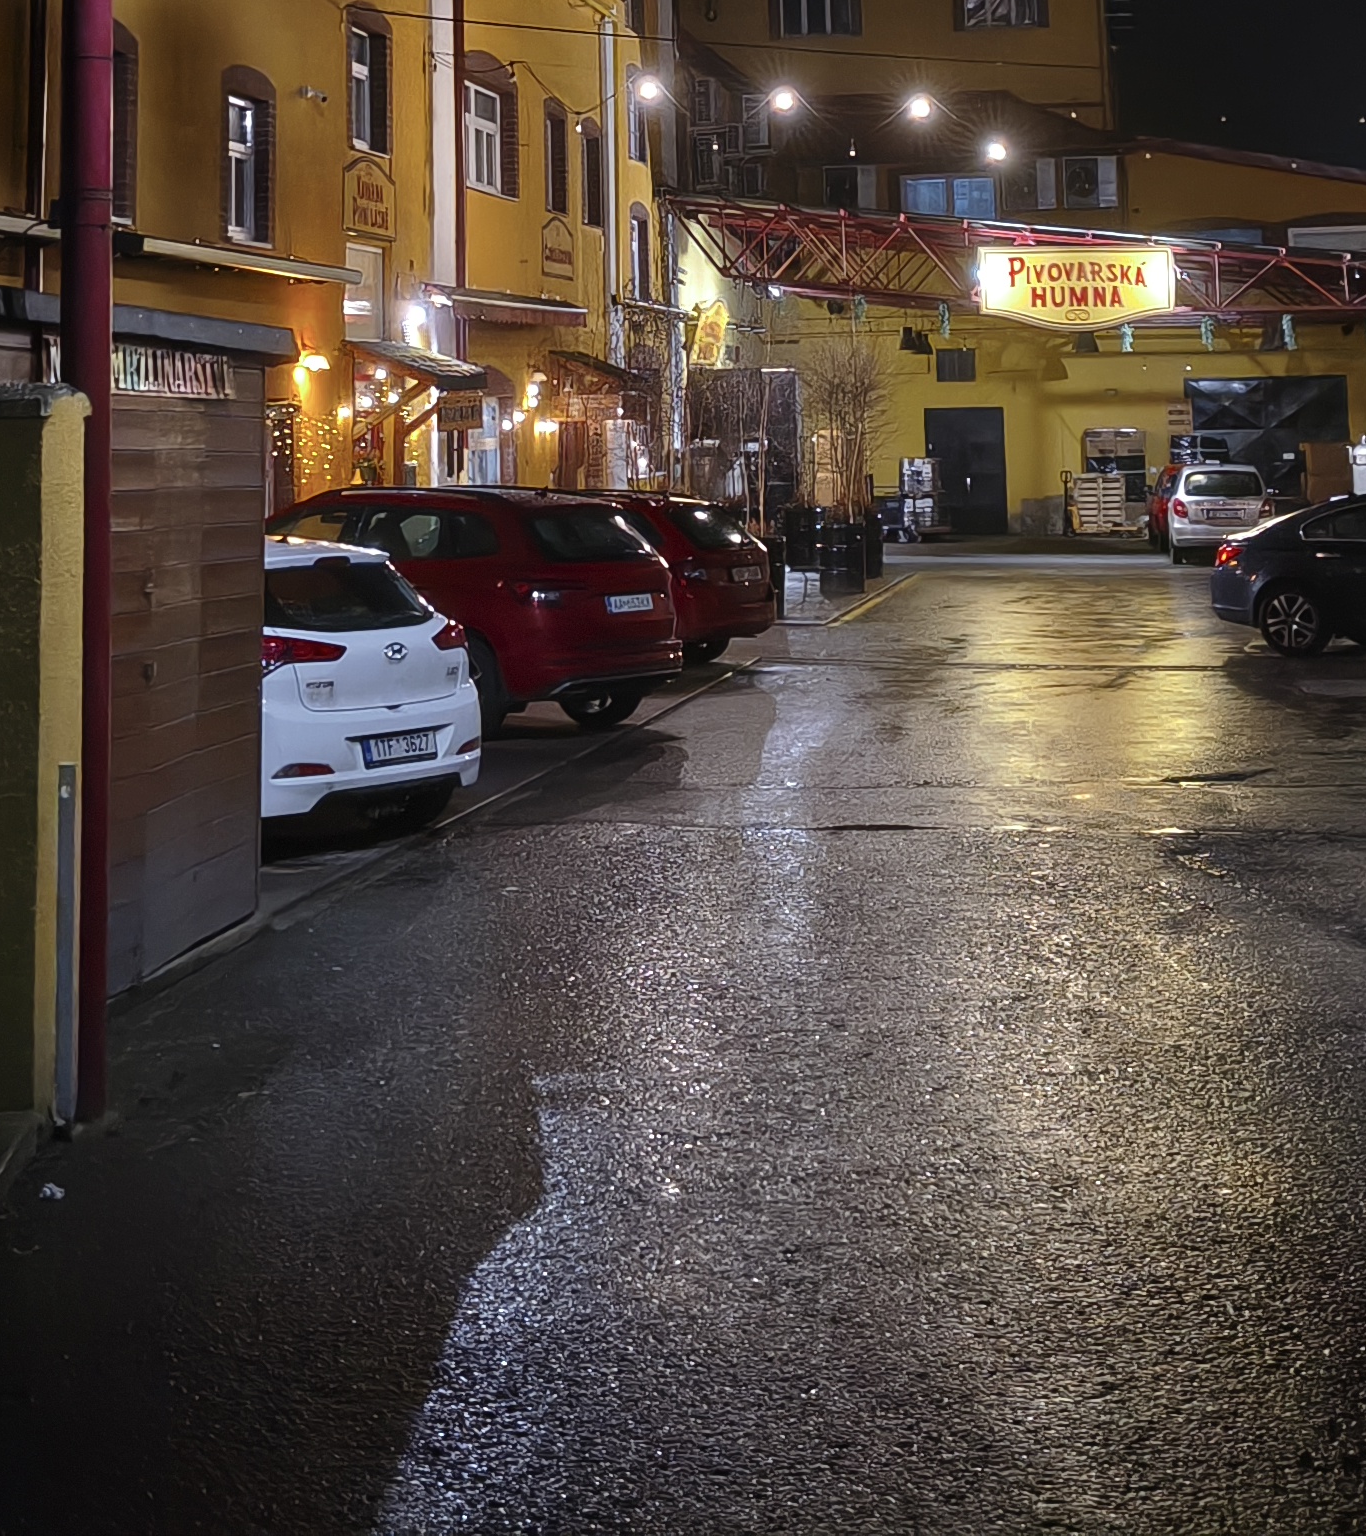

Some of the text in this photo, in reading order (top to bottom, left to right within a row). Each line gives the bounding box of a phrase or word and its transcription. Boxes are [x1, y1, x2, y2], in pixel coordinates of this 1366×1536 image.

[1007, 256, 1148, 288] PIVOVARSKÁ
[1031, 285, 1125, 308] HUMNA
[404, 733, 430, 754] 3627
